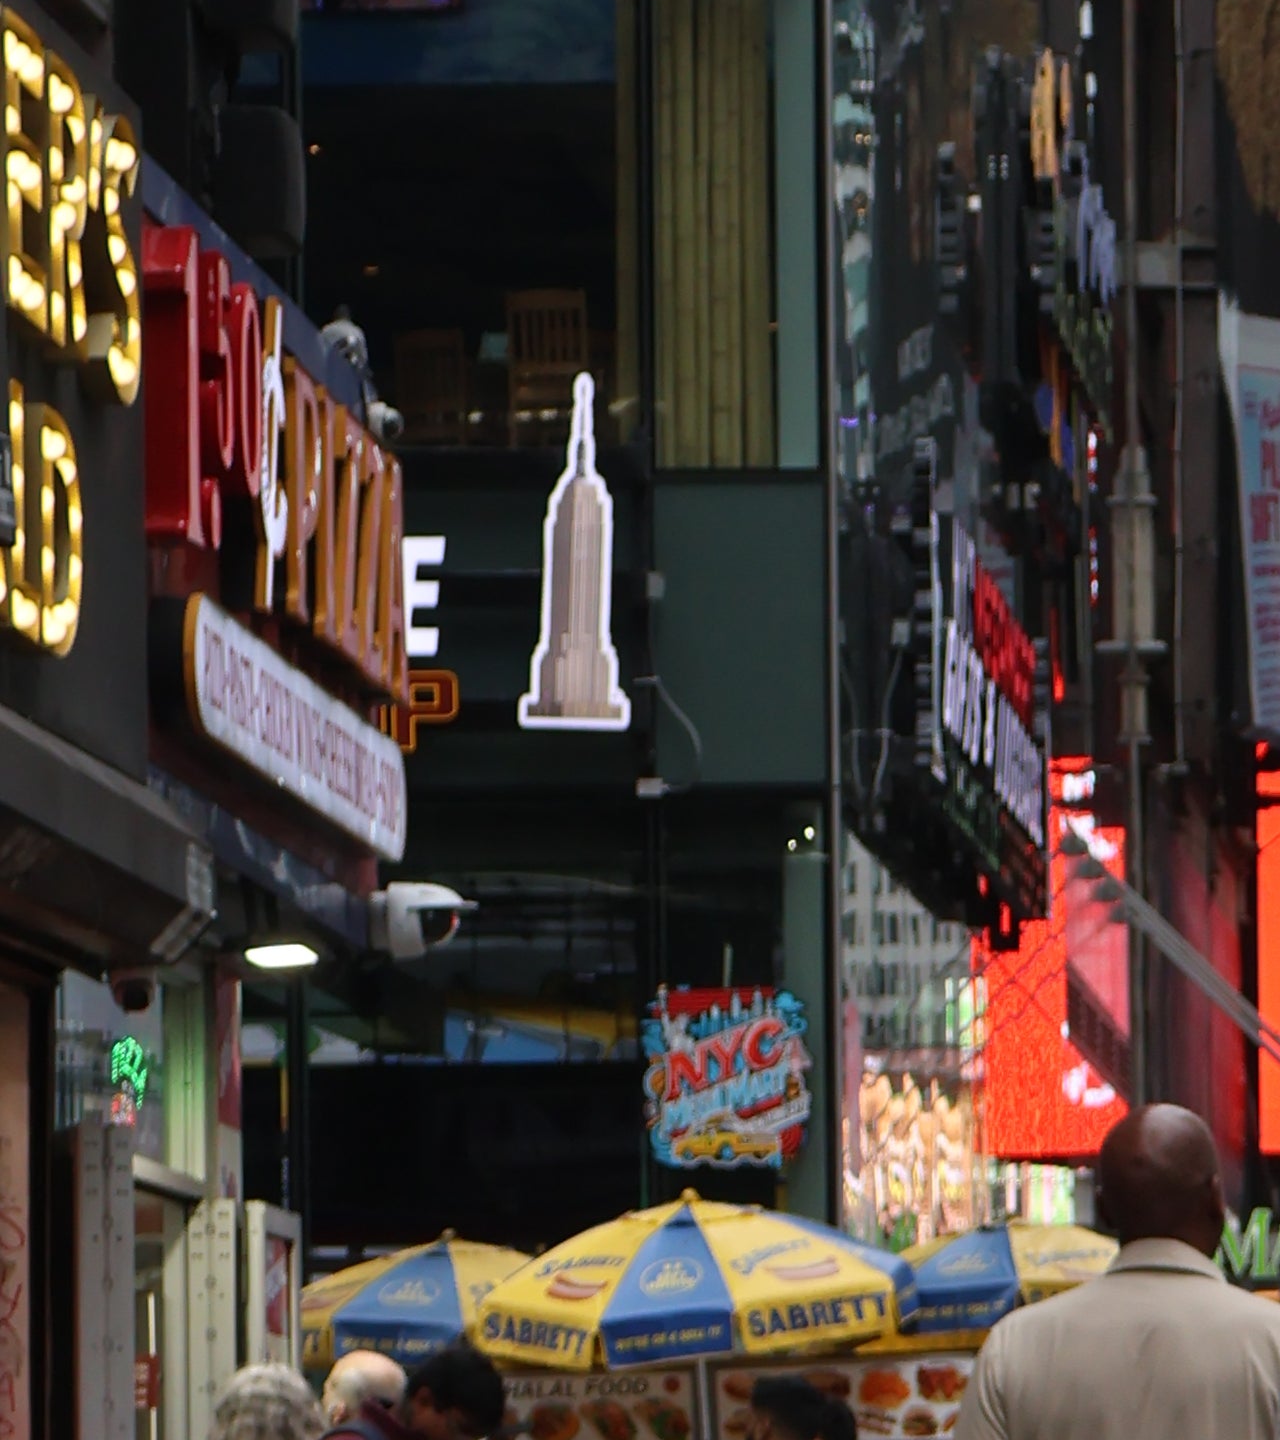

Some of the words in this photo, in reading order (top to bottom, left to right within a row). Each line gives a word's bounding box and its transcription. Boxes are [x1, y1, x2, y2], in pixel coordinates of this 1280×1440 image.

[284, 358, 408, 708] PIZZA
[665, 1017, 786, 1102] NYC
[484, 1312, 589, 1357] SABRETT
[749, 1291, 888, 1337] SABRETT
[510, 1376, 577, 1398] HALAL
[583, 1375, 650, 1396] FOOD
